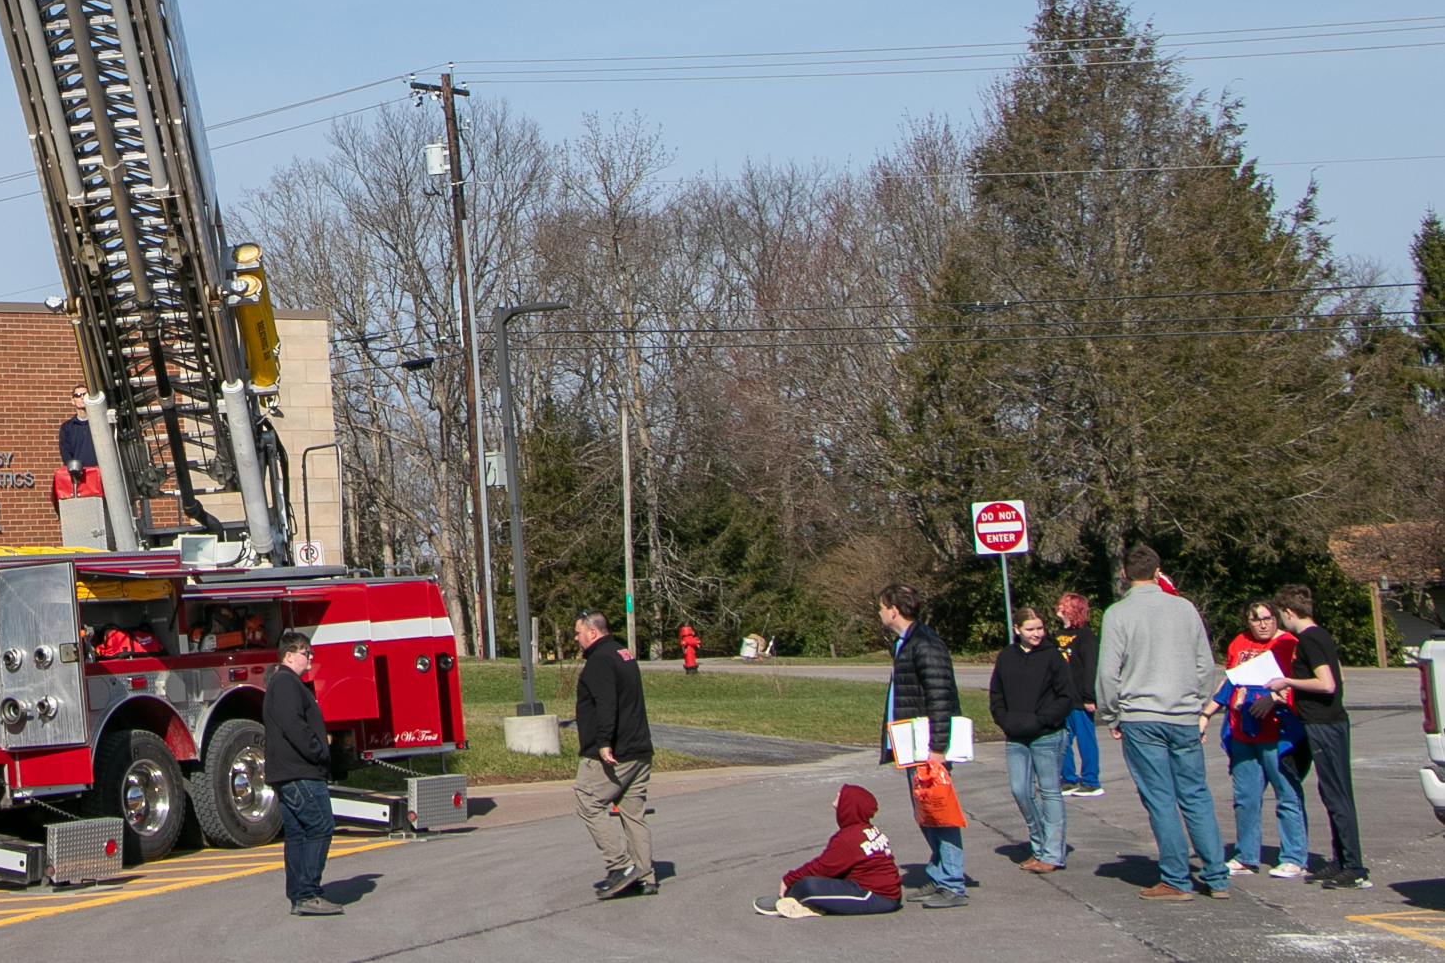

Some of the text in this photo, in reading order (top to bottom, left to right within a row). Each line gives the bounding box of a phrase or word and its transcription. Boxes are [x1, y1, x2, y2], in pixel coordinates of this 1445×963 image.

[981, 511, 1016, 521] DO NOT
[986, 534, 1016, 543] ENTER
